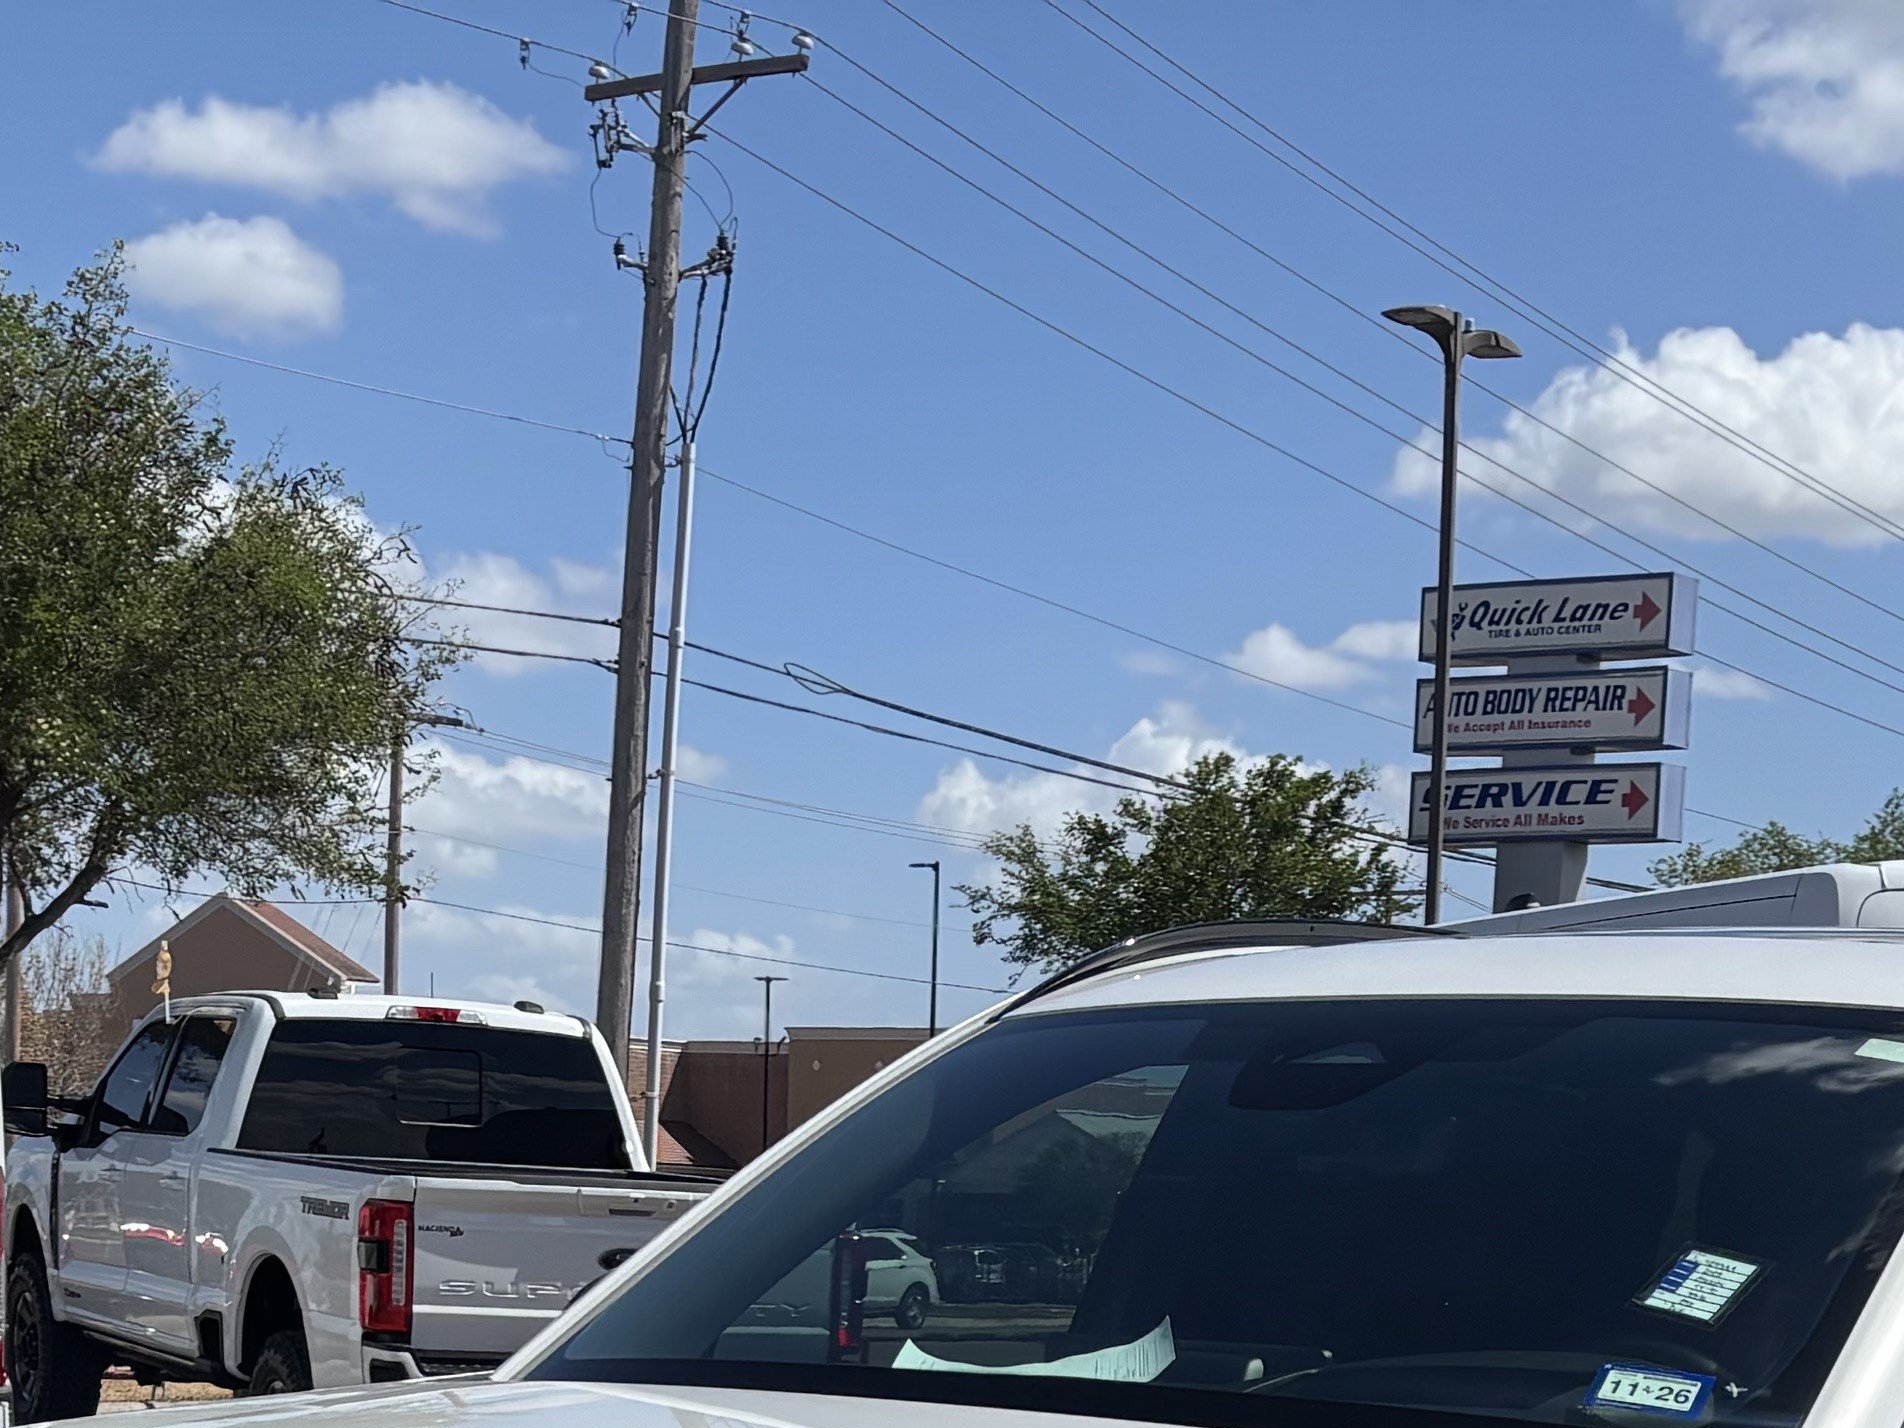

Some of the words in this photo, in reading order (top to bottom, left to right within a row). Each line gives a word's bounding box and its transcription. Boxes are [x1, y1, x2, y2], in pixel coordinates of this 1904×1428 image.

[1469, 598, 1550, 631] Quick
[1552, 597, 1630, 624] Lane
[1488, 629, 1511, 639] TIRE
[1524, 627, 1554, 637] AUTO
[1557, 624, 1602, 635] CENTER
[1422, 690, 1479, 719] ATO
[1482, 687, 1542, 716] BODY
[1543, 684, 1627, 713] REPAIR
[1463, 722, 1506, 734] Accept
[1508, 719, 1525, 731] All
[1527, 718, 1592, 731] Insurance
[1462, 816, 1510, 829] Service
[1513, 813, 1533, 826] All
[1537, 813, 1585, 826] Makes
